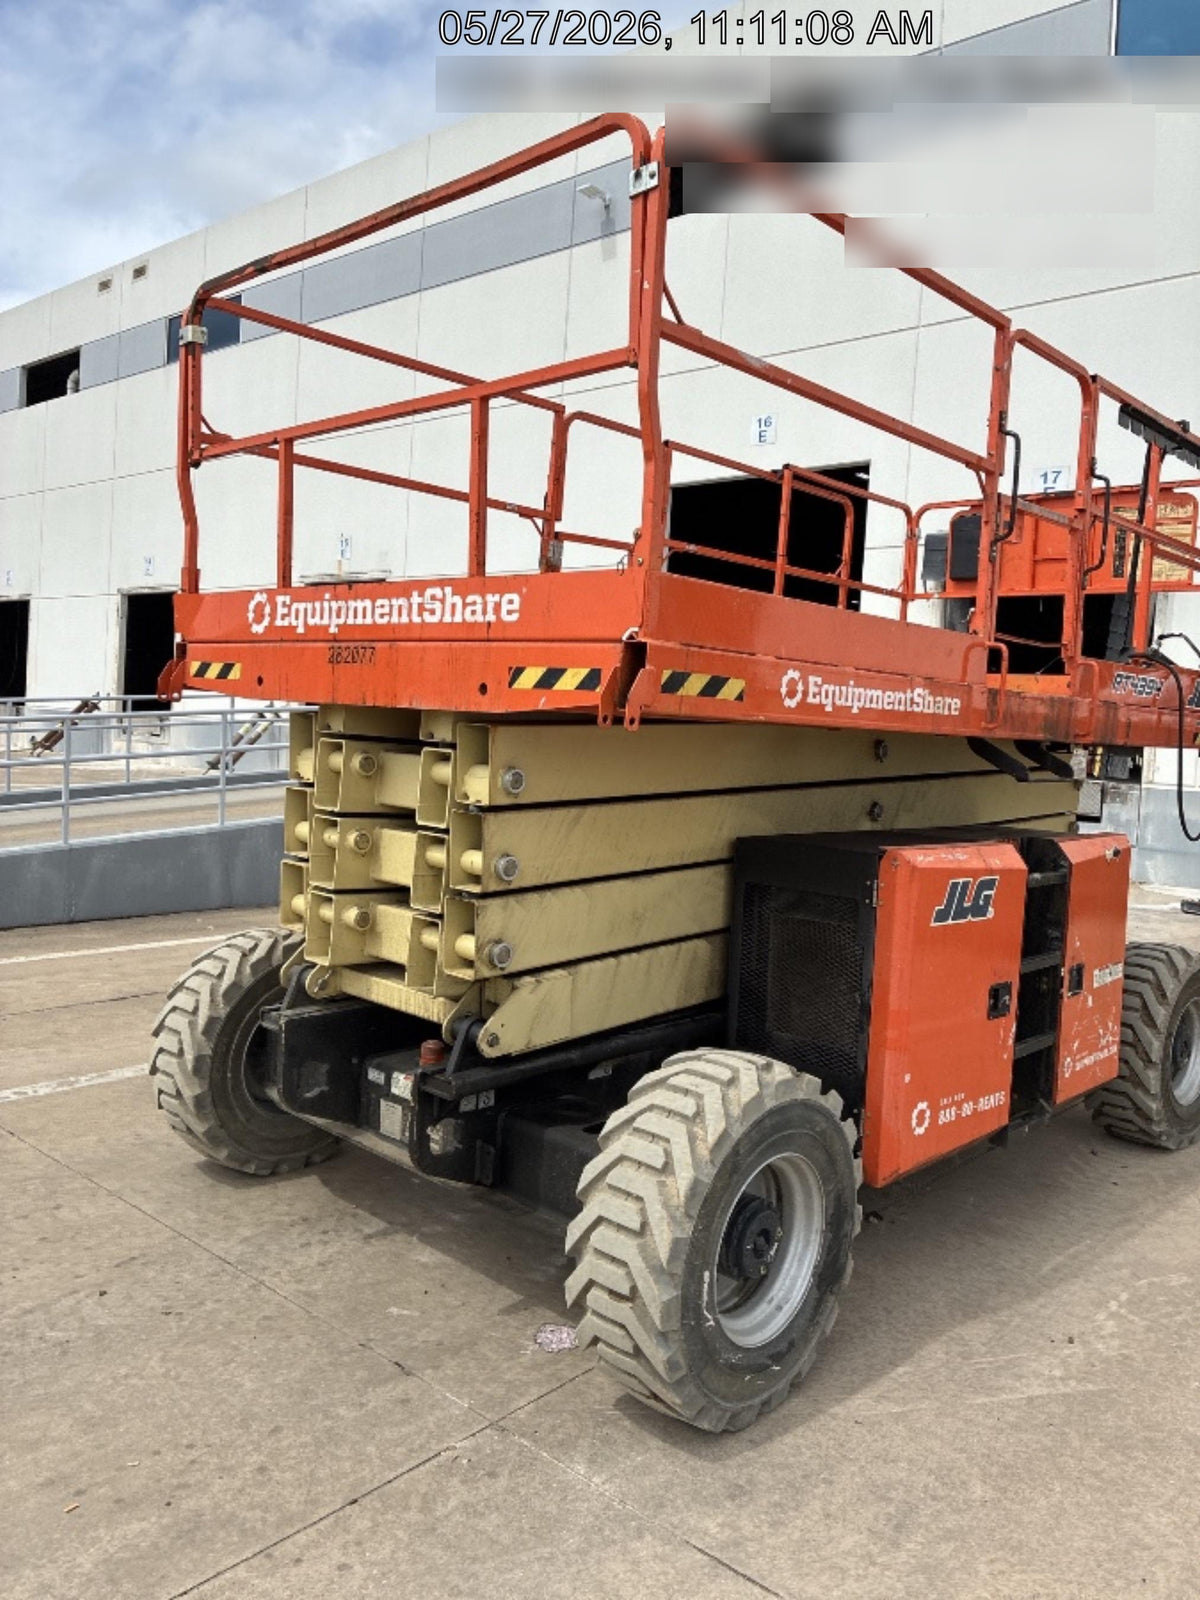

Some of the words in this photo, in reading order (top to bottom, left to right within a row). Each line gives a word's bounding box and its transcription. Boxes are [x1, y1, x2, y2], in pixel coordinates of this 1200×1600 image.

[757, 415, 772, 429] 16
[758, 429, 767, 443] E
[1040, 470, 1062, 484] 17
[274, 586, 520, 634] EquipmentShare
[328, 644, 376, 664] 282077
[807, 675, 961, 716] EquipmentShare
[930, 875, 1000, 926] JLG
